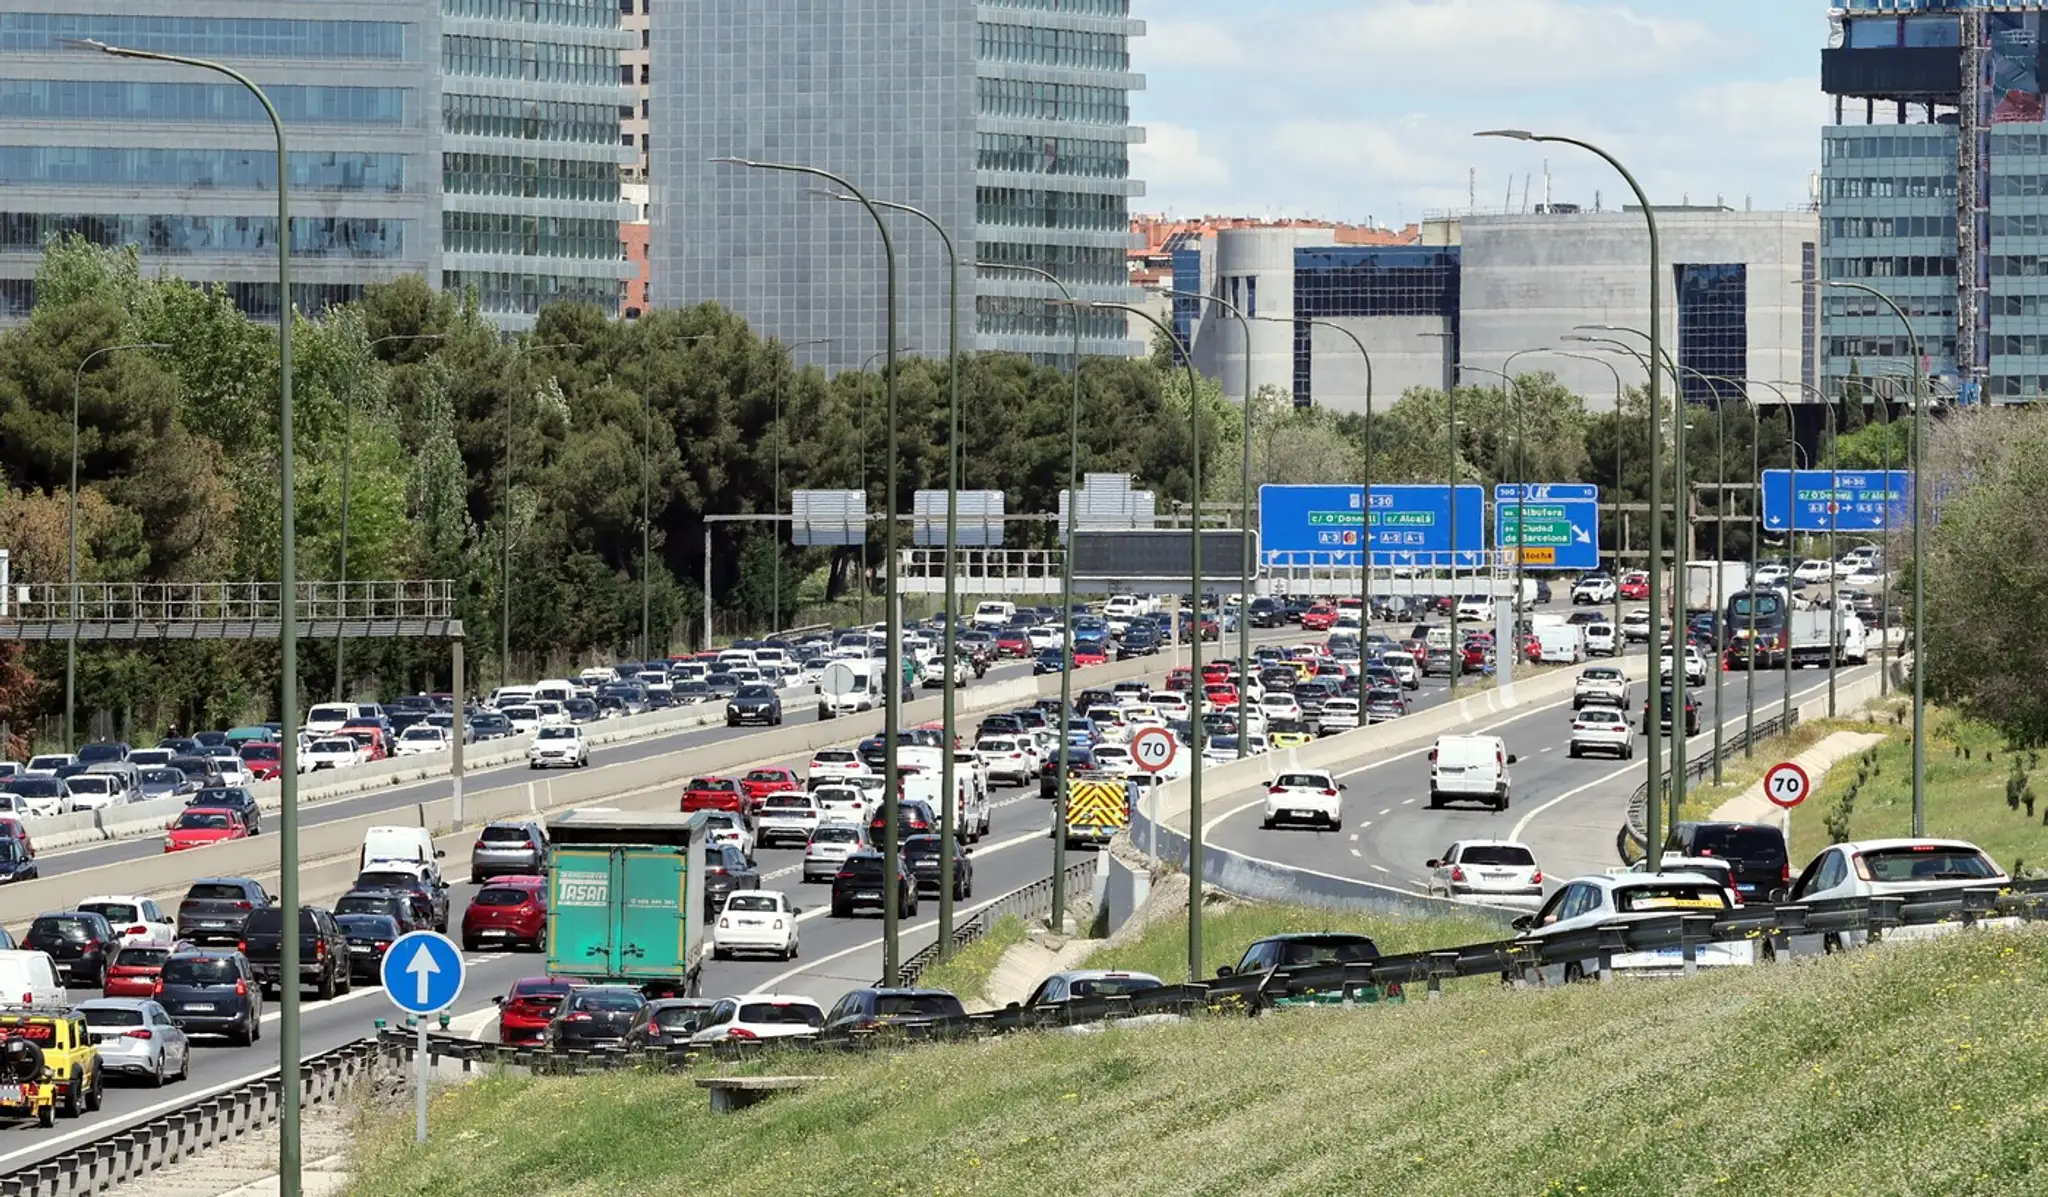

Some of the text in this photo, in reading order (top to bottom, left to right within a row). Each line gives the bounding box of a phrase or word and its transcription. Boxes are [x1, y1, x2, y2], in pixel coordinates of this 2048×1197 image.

[1522, 508, 1562, 516] Albufera
[1312, 513, 1431, 523] c/ O'Donnll c/ Alcalá
[1522, 524, 1553, 532] Ciudad
[1320, 533, 1422, 541] A-3 A-2 A-1
[1505, 534, 1568, 542] de Barcelona
[1142, 742, 1166, 757] 70
[1774, 778, 1799, 792] 70
[559, 880, 608, 900] TASAN
